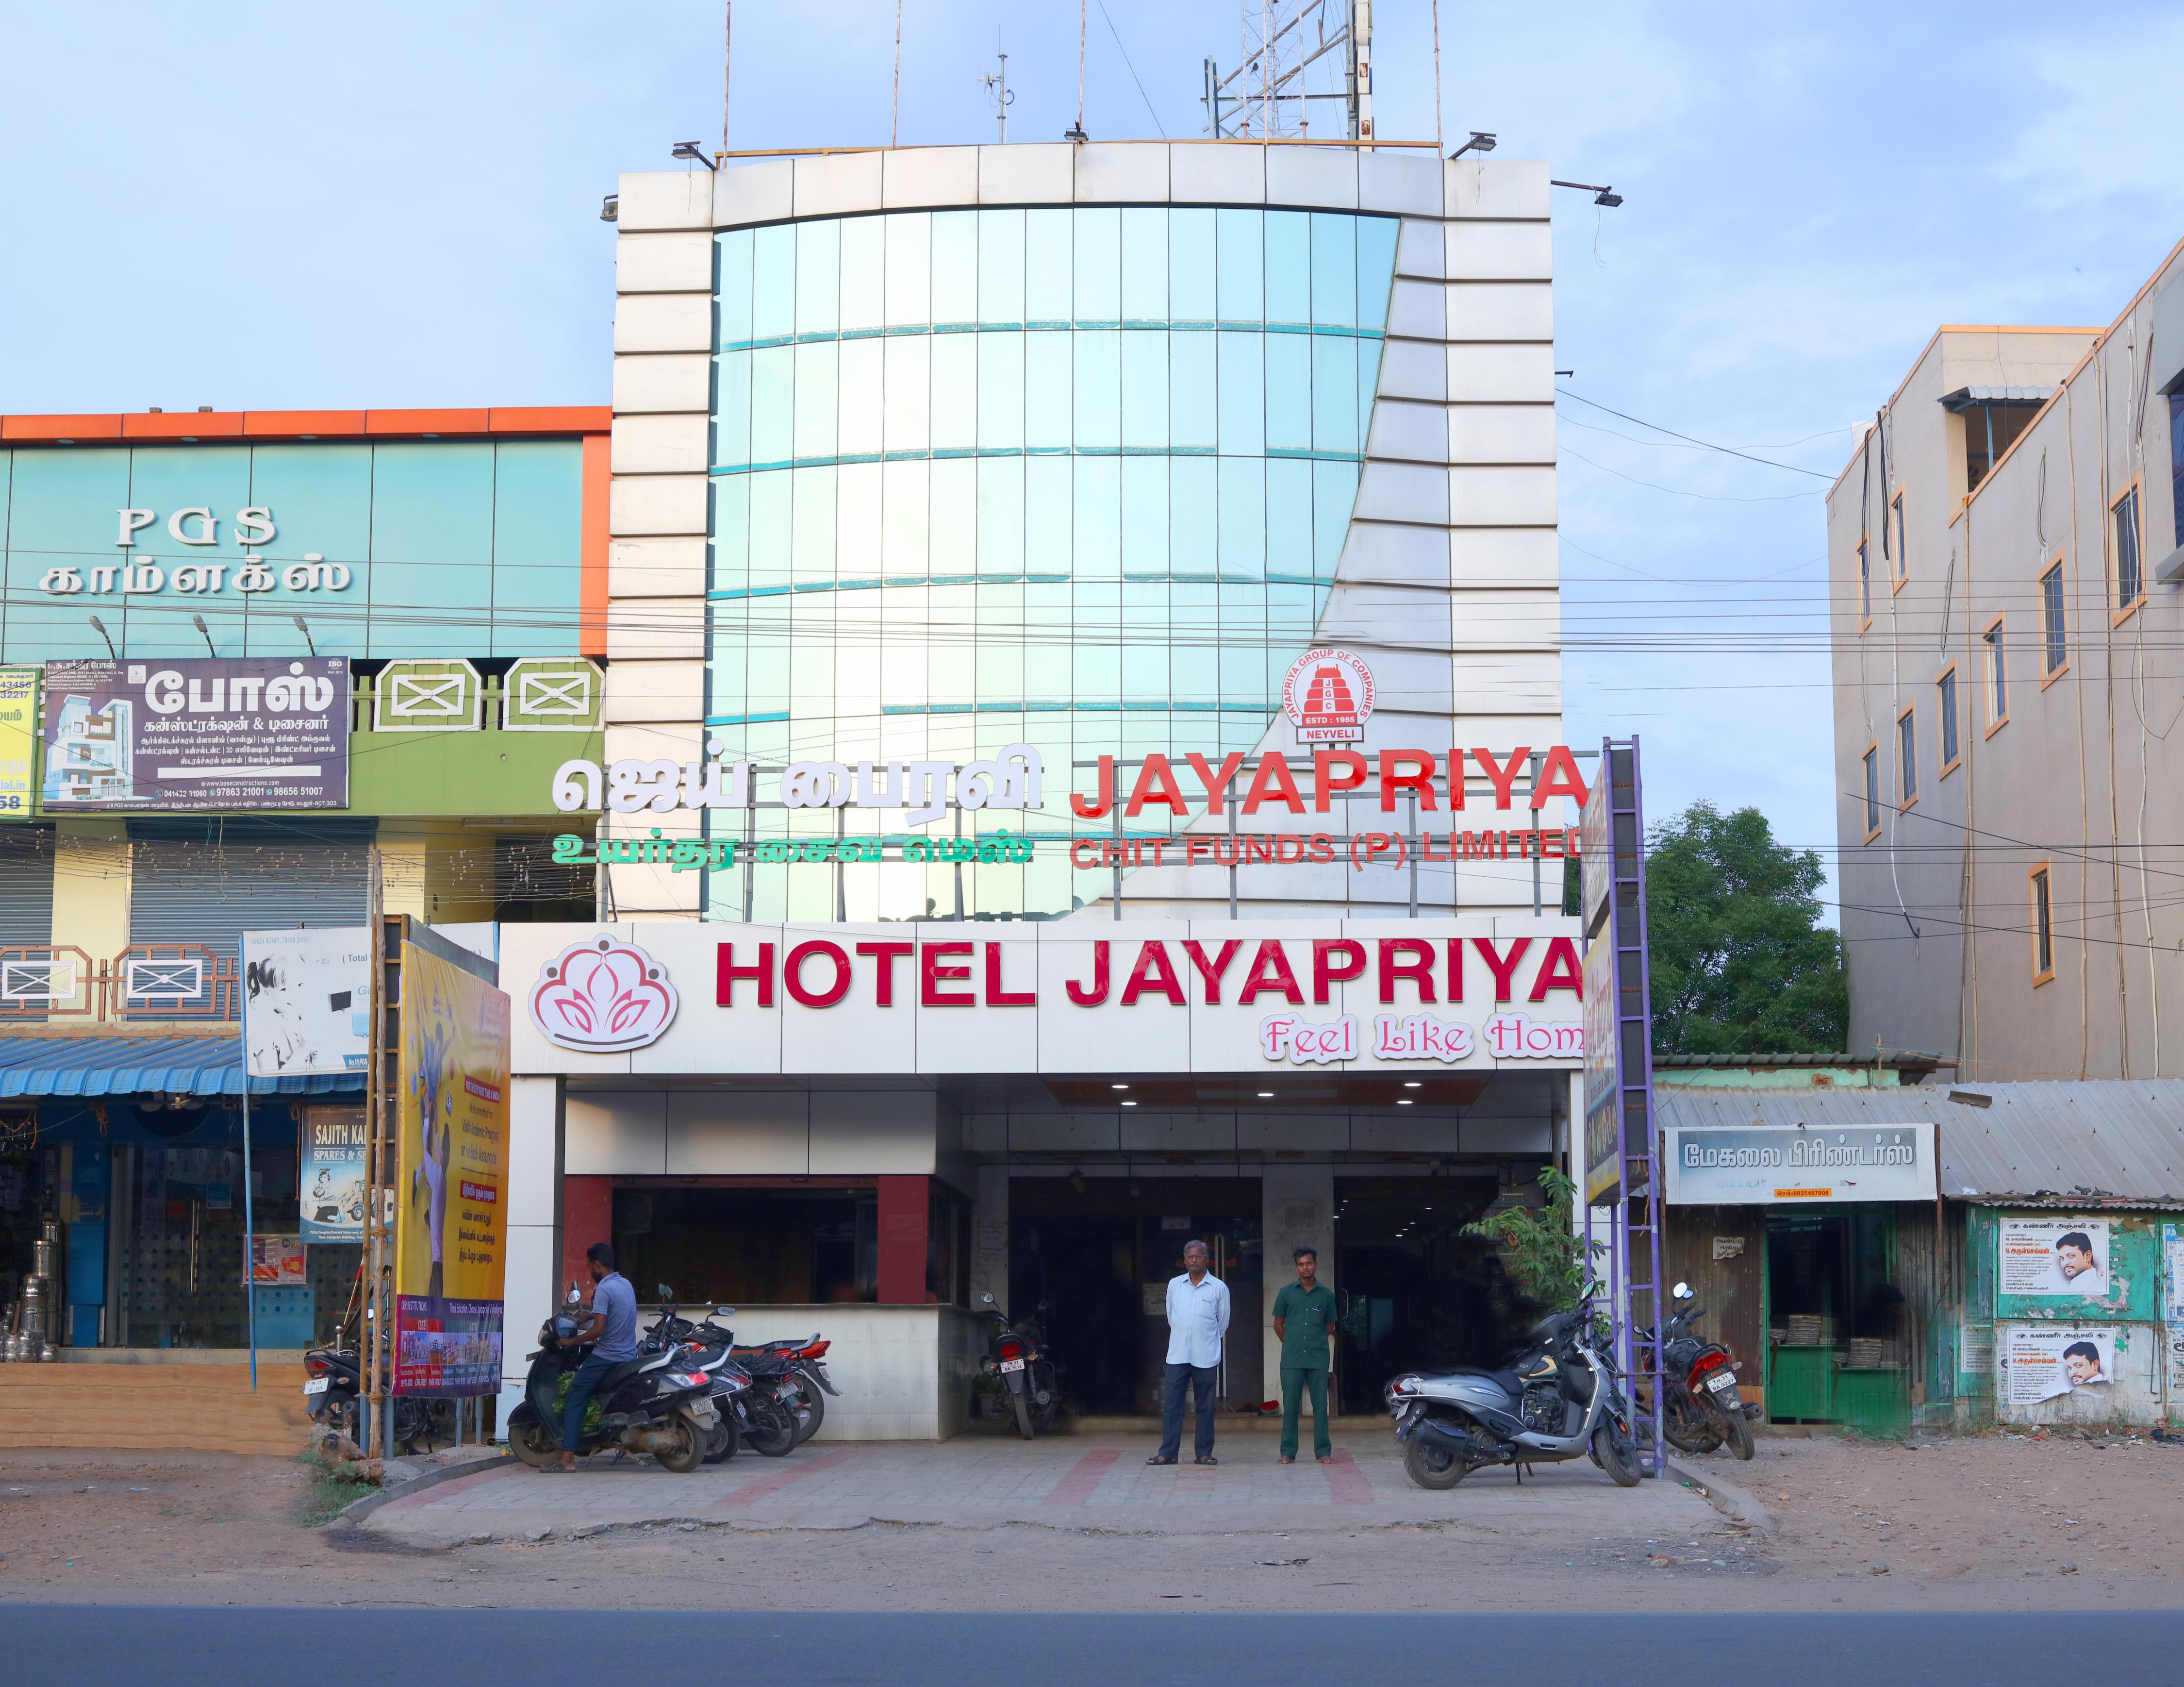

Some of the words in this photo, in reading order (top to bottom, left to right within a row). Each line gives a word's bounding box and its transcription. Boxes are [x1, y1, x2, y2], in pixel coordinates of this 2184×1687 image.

[91, 660, 116, 669] போஸ்
[145, 662, 334, 714] போஸ்
[1284, 667, 1300, 719] JAYAPRIYA
[1298, 649, 1334, 667] GROUP
[1337, 651, 1351, 661] OF
[1352, 659, 1373, 718] COMPANIES
[253, 717, 264, 730] &
[269, 714, 329, 732] டிசைனர்
[1307, 729, 1355, 739] NEYVELI
[552, 738, 749, 814] ஜெய்
[779, 742, 1042, 827] பைரவி
[1069, 745, 1590, 819] JAYAPRIYA
[216, 787, 240, 797] 97863
[242, 787, 265, 796] 21001
[274, 787, 298, 796] 98656
[300, 787, 323, 796] 51007
[552, 828, 738, 873] உயர்தர
[756, 835, 882, 864] சைவ
[902, 829, 1034, 865] மெஸ்
[1069, 837, 1172, 870] CHIT
[1186, 832, 1335, 867] FUNDS
[1350, 832, 1406, 871] (P)
[251, 936, 265, 944] 99421
[716, 939, 1037, 1007] HOTEL
[1065, 937, 1583, 1007] JAYAPRIYA
[1267, 1019, 1355, 1054] Feel
[1380, 1019, 1468, 1054] Like
[1490, 1019, 1584, 1053] Hom
[315, 1125, 348, 1145] SAJITH
[314, 1151, 346, 1160] SPARES
[347, 1151, 355, 1160] &
[1684, 1143, 1782, 1167] மேகலை
[1787, 1133, 1913, 1167] பிரிண்டர்ஸ்
[2005, 1247, 2050, 1255] M.அருள்செல்வன்
[408, 1301, 427, 1311] INSTITUTIONS
[418, 1320, 426, 1330] CBSE
[1712, 1379, 1734, 1391] BA.9227
